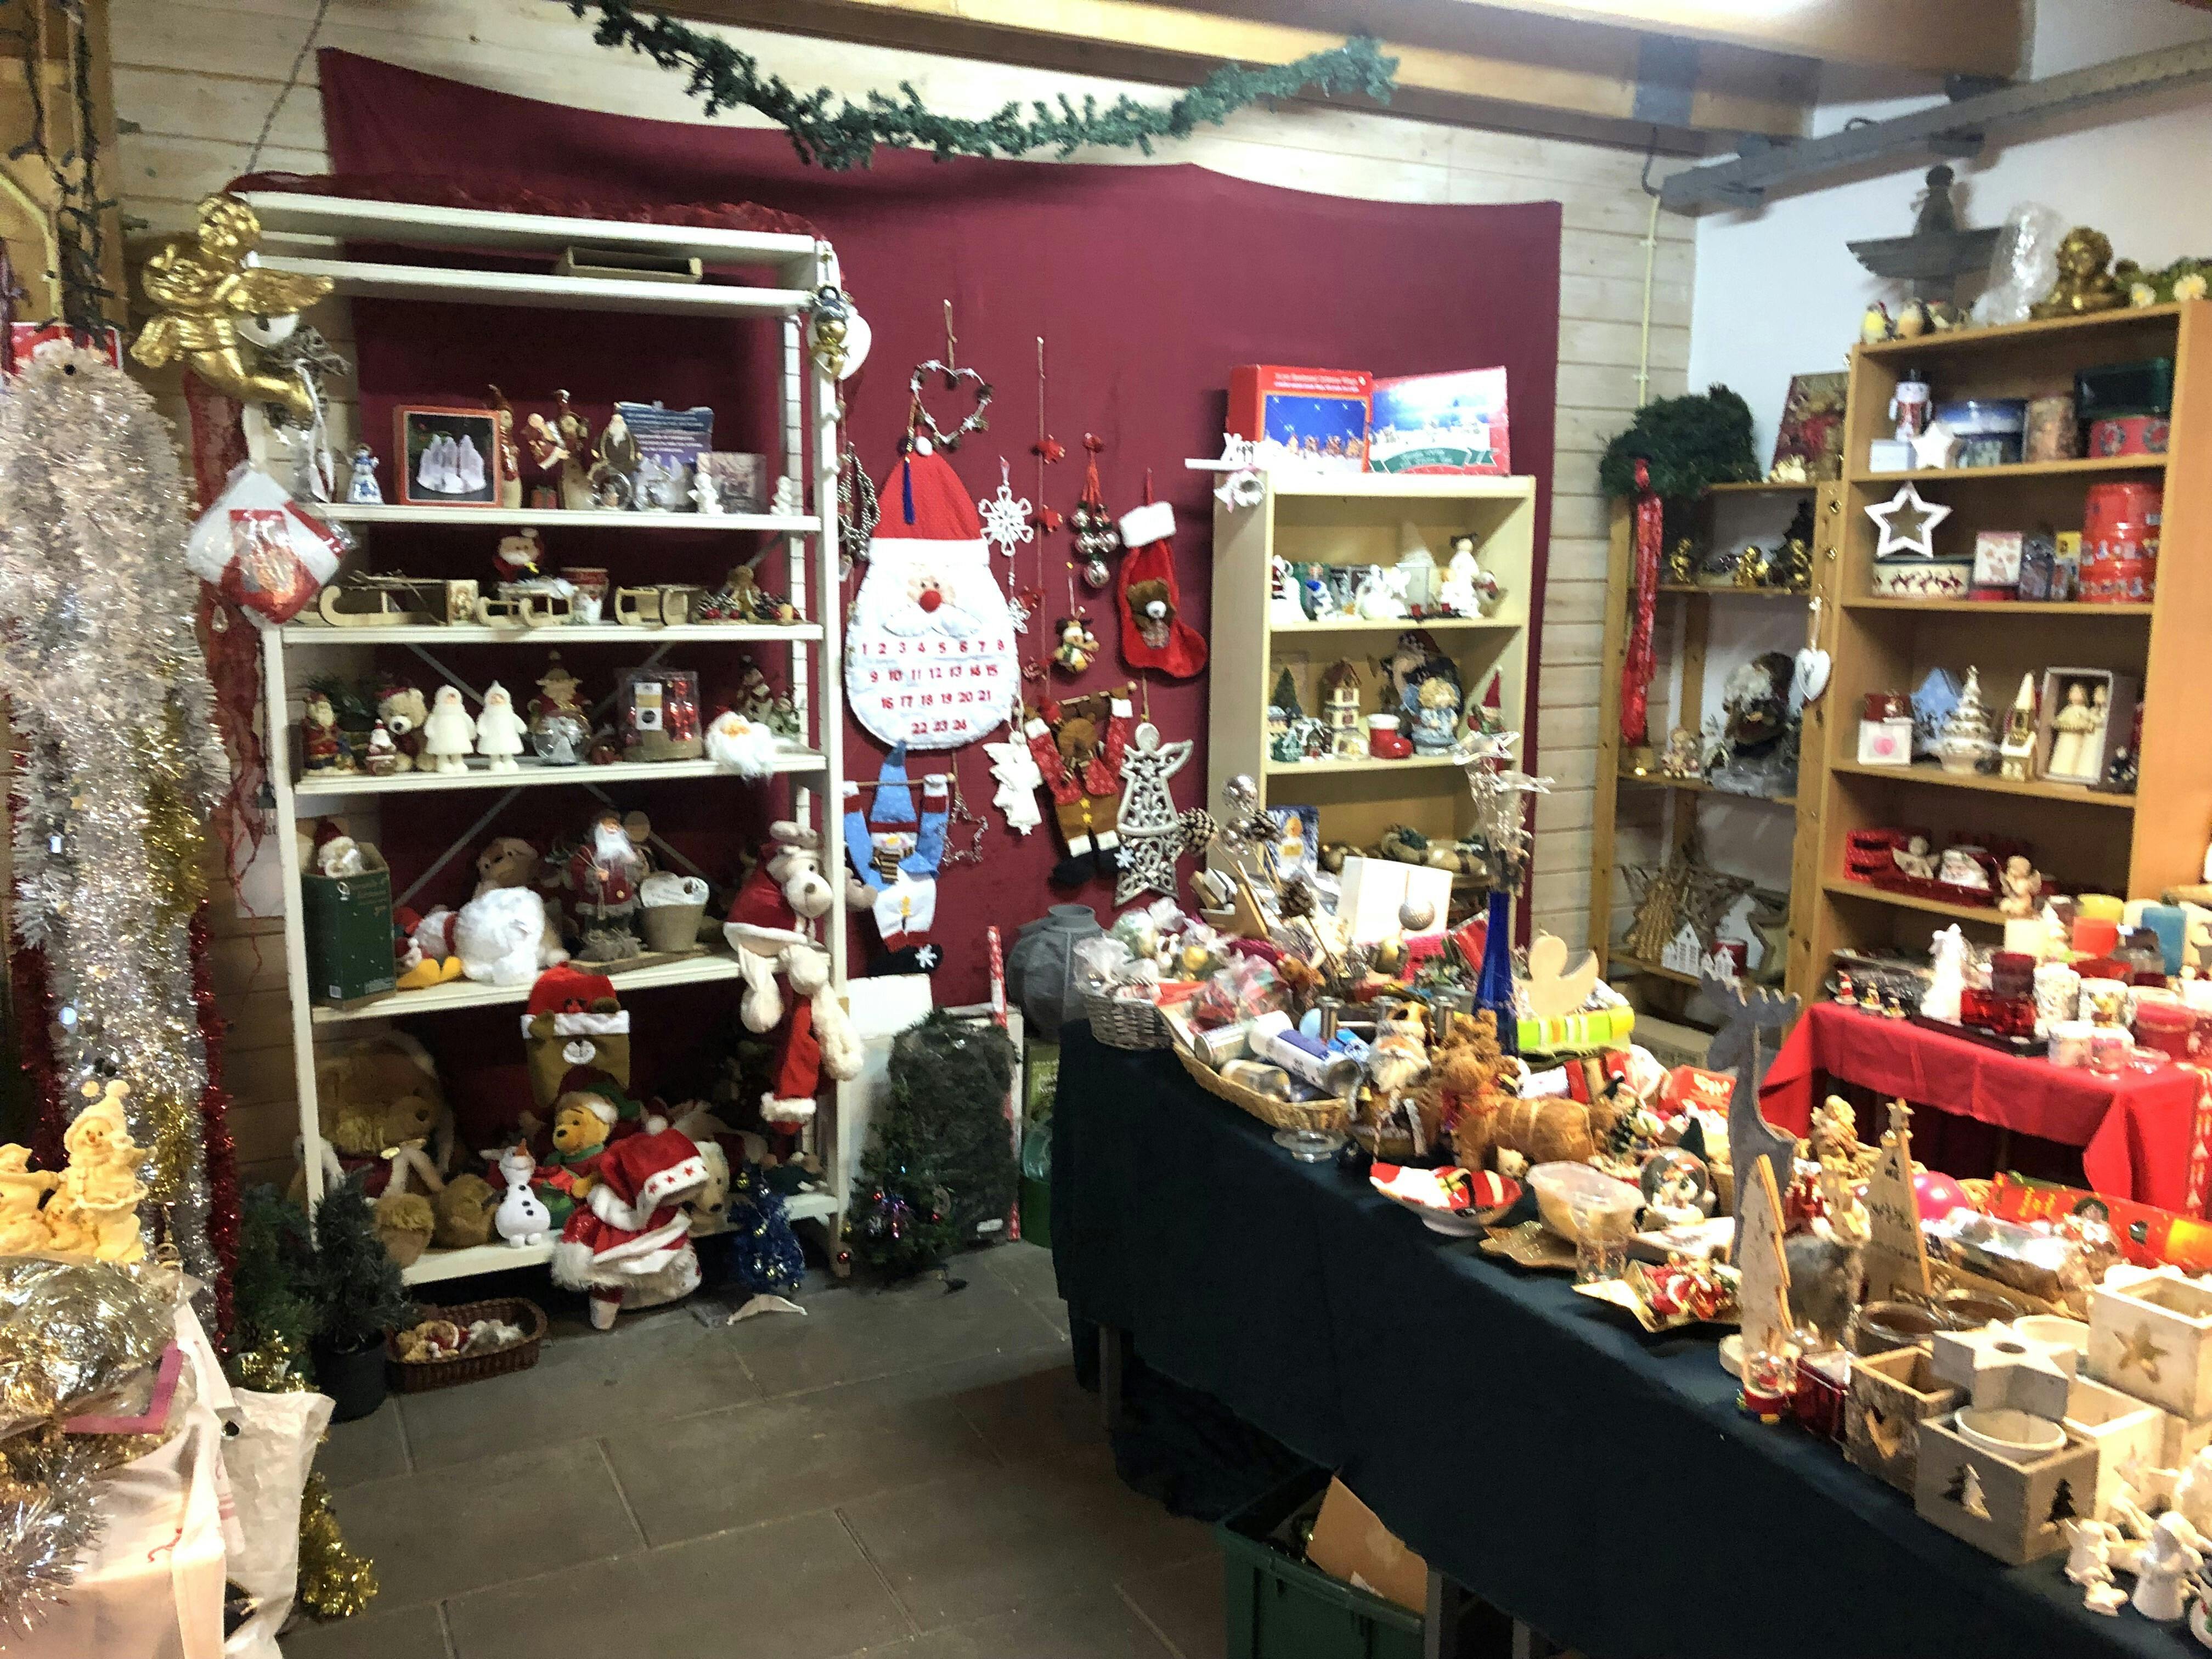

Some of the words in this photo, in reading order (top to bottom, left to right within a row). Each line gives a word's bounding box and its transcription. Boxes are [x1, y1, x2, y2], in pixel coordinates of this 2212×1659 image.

[862, 643, 867, 655] 1
[878, 642, 887, 654] 2
[899, 641, 906, 653] 3
[917, 642, 926, 653] 4
[938, 641, 946, 653] 5
[978, 640, 986, 652] 7
[870, 670, 879, 682] 9
[888, 669, 903, 681] 10
[911, 669, 921, 680] 11
[929, 667, 942, 679] 12
[949, 665, 962, 678] 13
[985, 664, 998, 676] 15
[881, 697, 894, 709] 16
[900, 695, 913, 708] 17
[921, 694, 933, 706] 18
[941, 693, 953, 704] 19
[958, 691, 973, 703] 20
[978, 690, 991, 702] 21
[911, 722, 928, 735] 22
[933, 719, 948, 732] 23
[952, 719, 967, 731] 24
